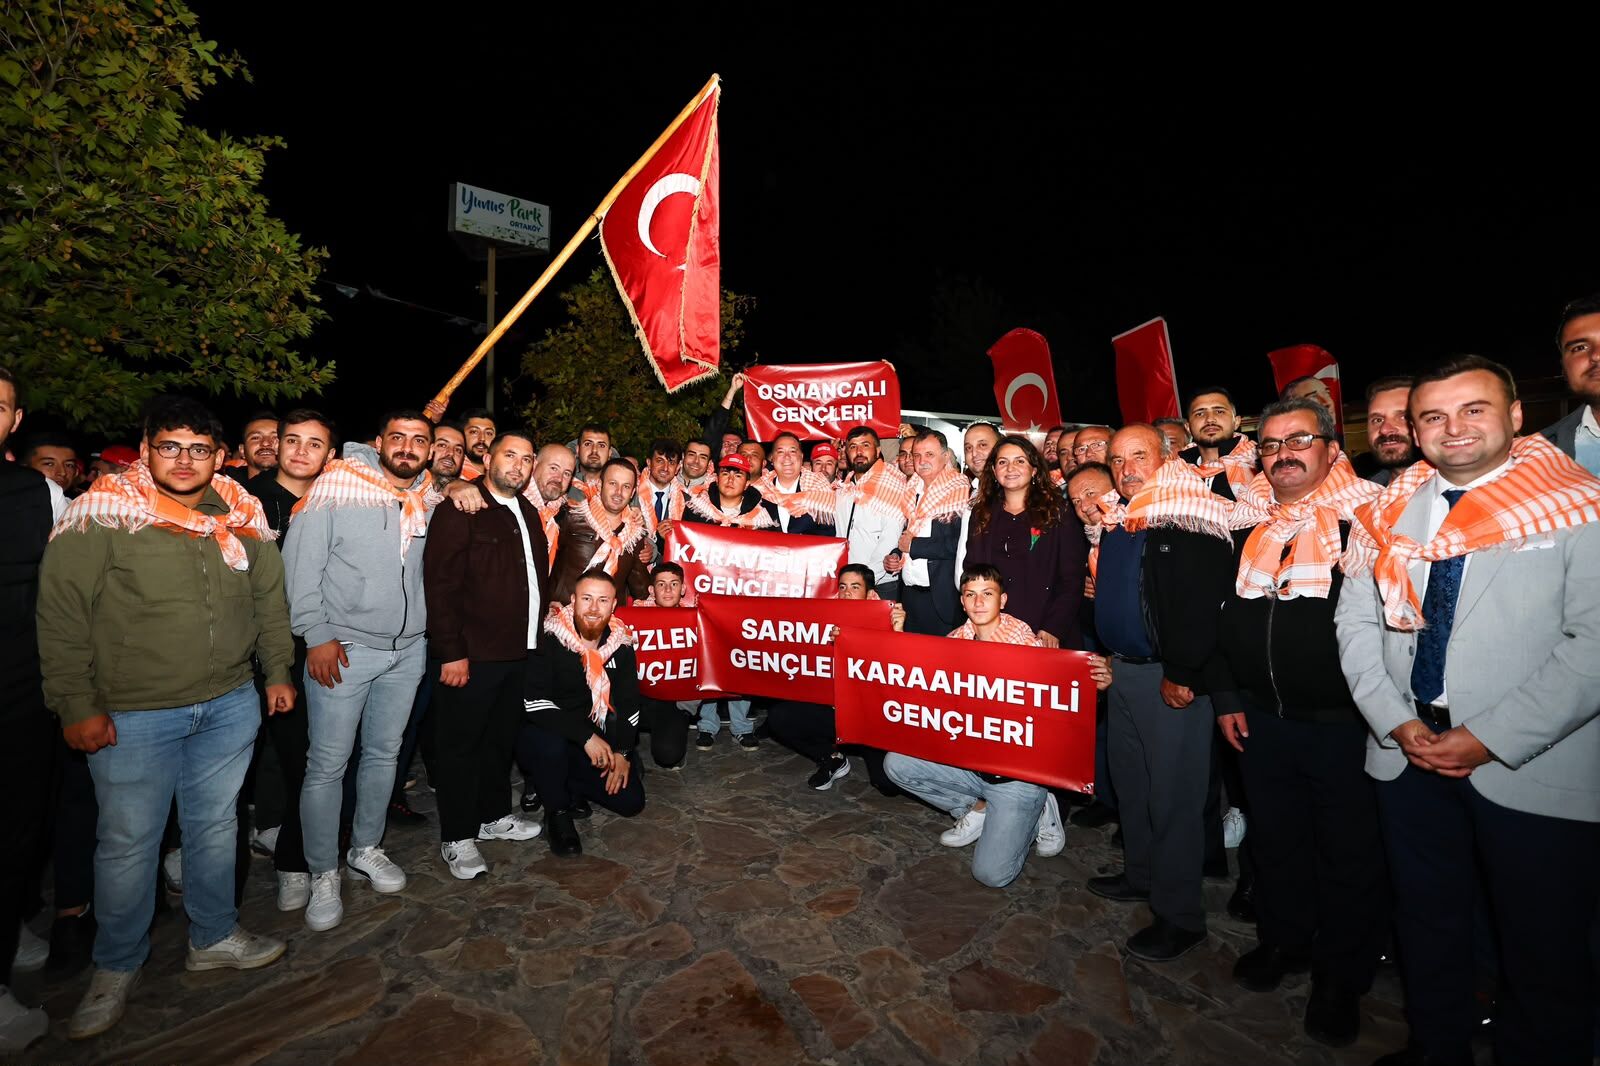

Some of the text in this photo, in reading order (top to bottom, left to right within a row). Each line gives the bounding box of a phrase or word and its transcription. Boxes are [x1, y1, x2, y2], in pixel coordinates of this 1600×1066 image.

[461, 186, 544, 227] Yunus Park
[757, 380, 886, 400] OSMANCALI
[771, 400, 873, 427] GENÇLERİ
[730, 648, 835, 680] GENÇLE
[847, 657, 1079, 713] KARAAHMETLİ
[882, 700, 1034, 747] GENÇLERİ
